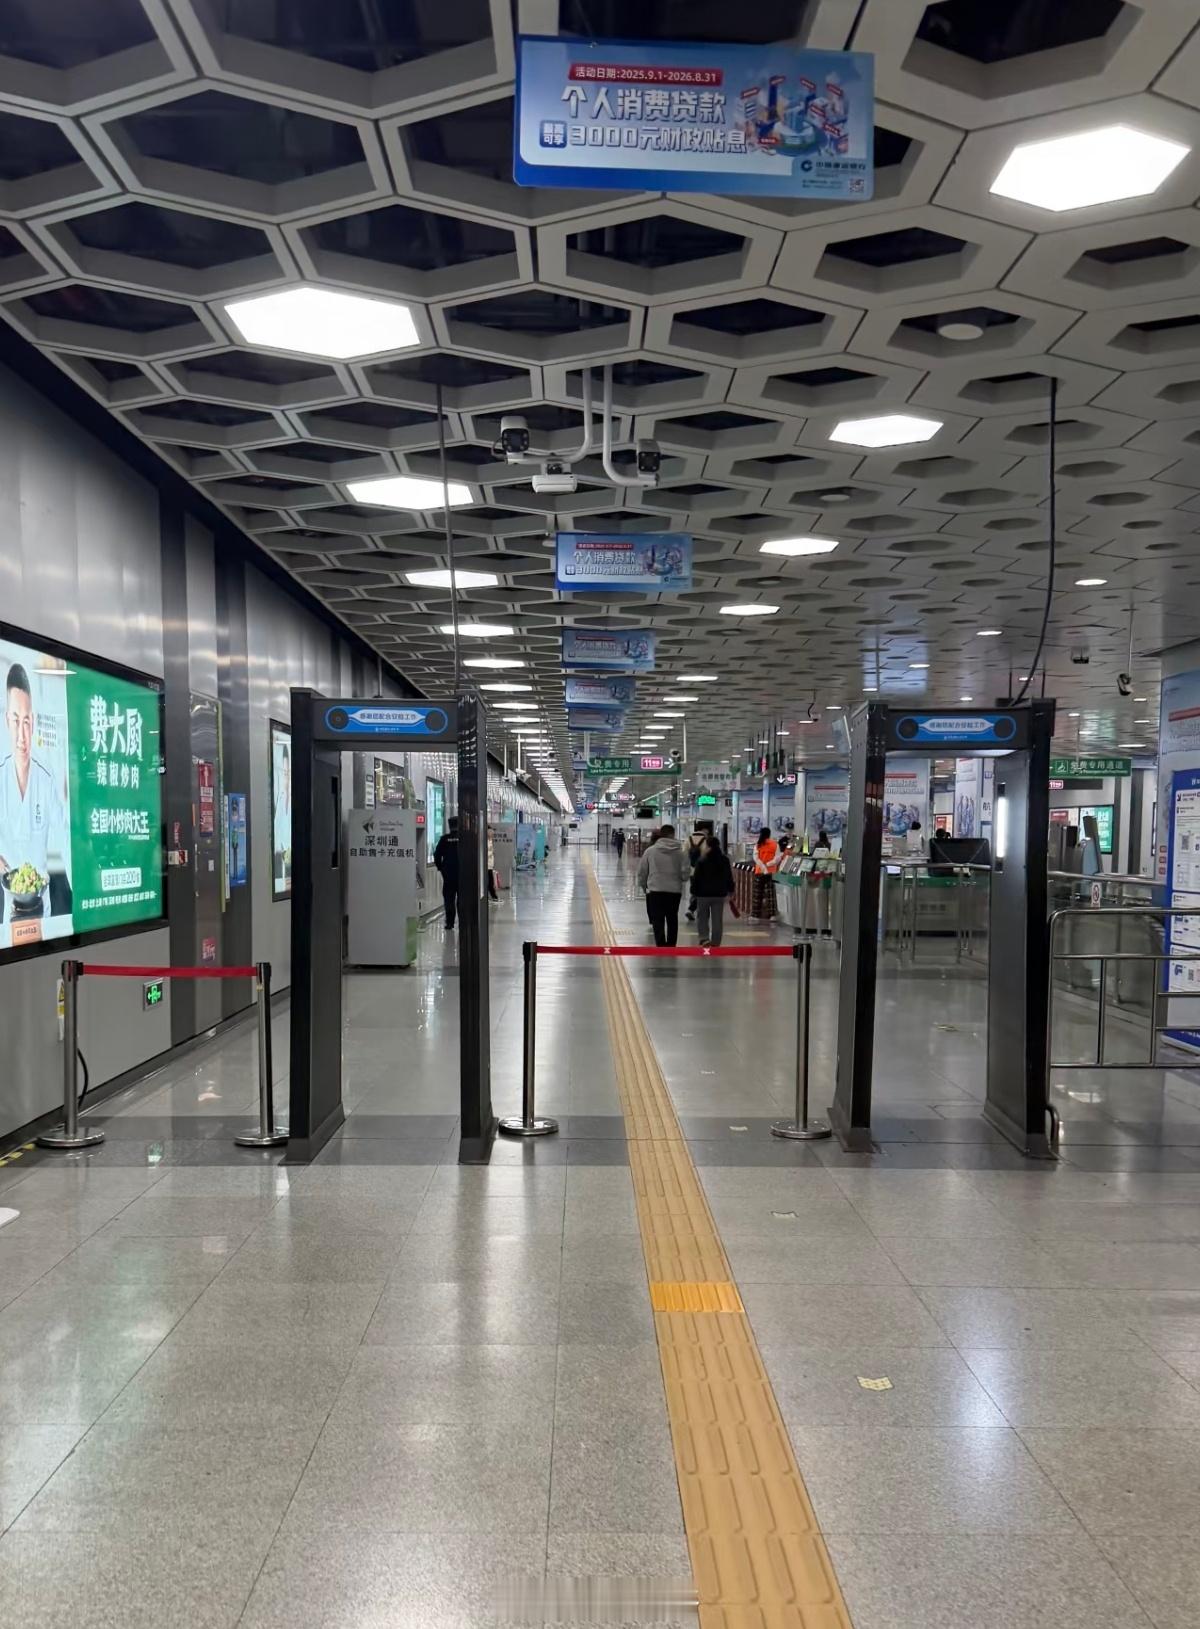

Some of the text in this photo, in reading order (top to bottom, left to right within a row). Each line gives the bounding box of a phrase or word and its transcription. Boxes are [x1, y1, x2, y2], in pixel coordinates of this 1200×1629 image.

[575, 66, 717, 83] 活动日期:2025.9.1-2026.8.31
[561, 86, 726, 124] 个人消费贷款
[569, 125, 748, 154] 3000元财政贴息
[90, 694, 143, 761] 费大厨
[97, 758, 140, 789] 辣椒炒肉
[90, 808, 150, 834] 全国小炒肉大王
[350, 848, 415, 858] 自助售卡充值机
[365, 835, 399, 846] 深圳通
